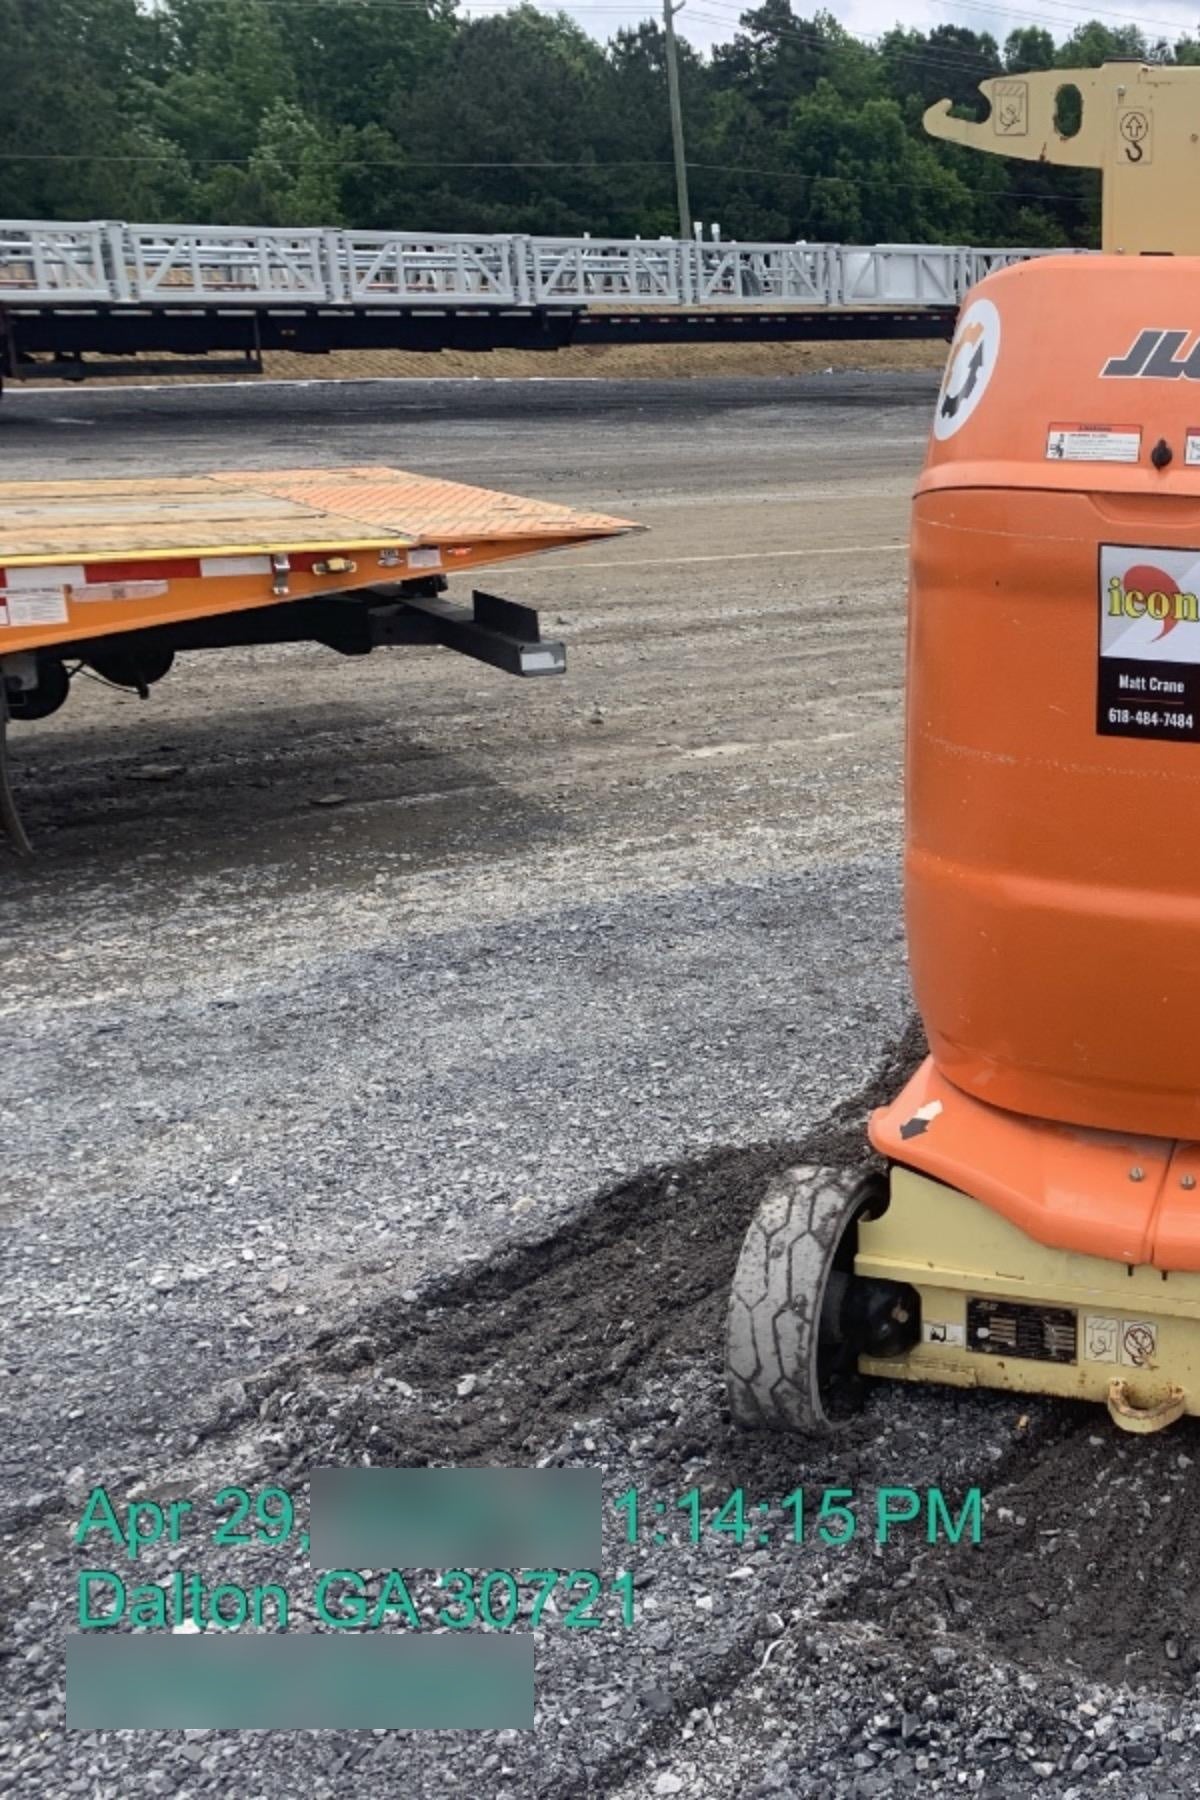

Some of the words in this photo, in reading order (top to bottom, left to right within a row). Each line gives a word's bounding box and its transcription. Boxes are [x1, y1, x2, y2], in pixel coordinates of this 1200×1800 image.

[1108, 577, 1200, 622] icon
[1119, 674, 1146, 690] Matt
[1149, 677, 1185, 693] Crane
[1108, 708, 1194, 728] 618-484-7484
